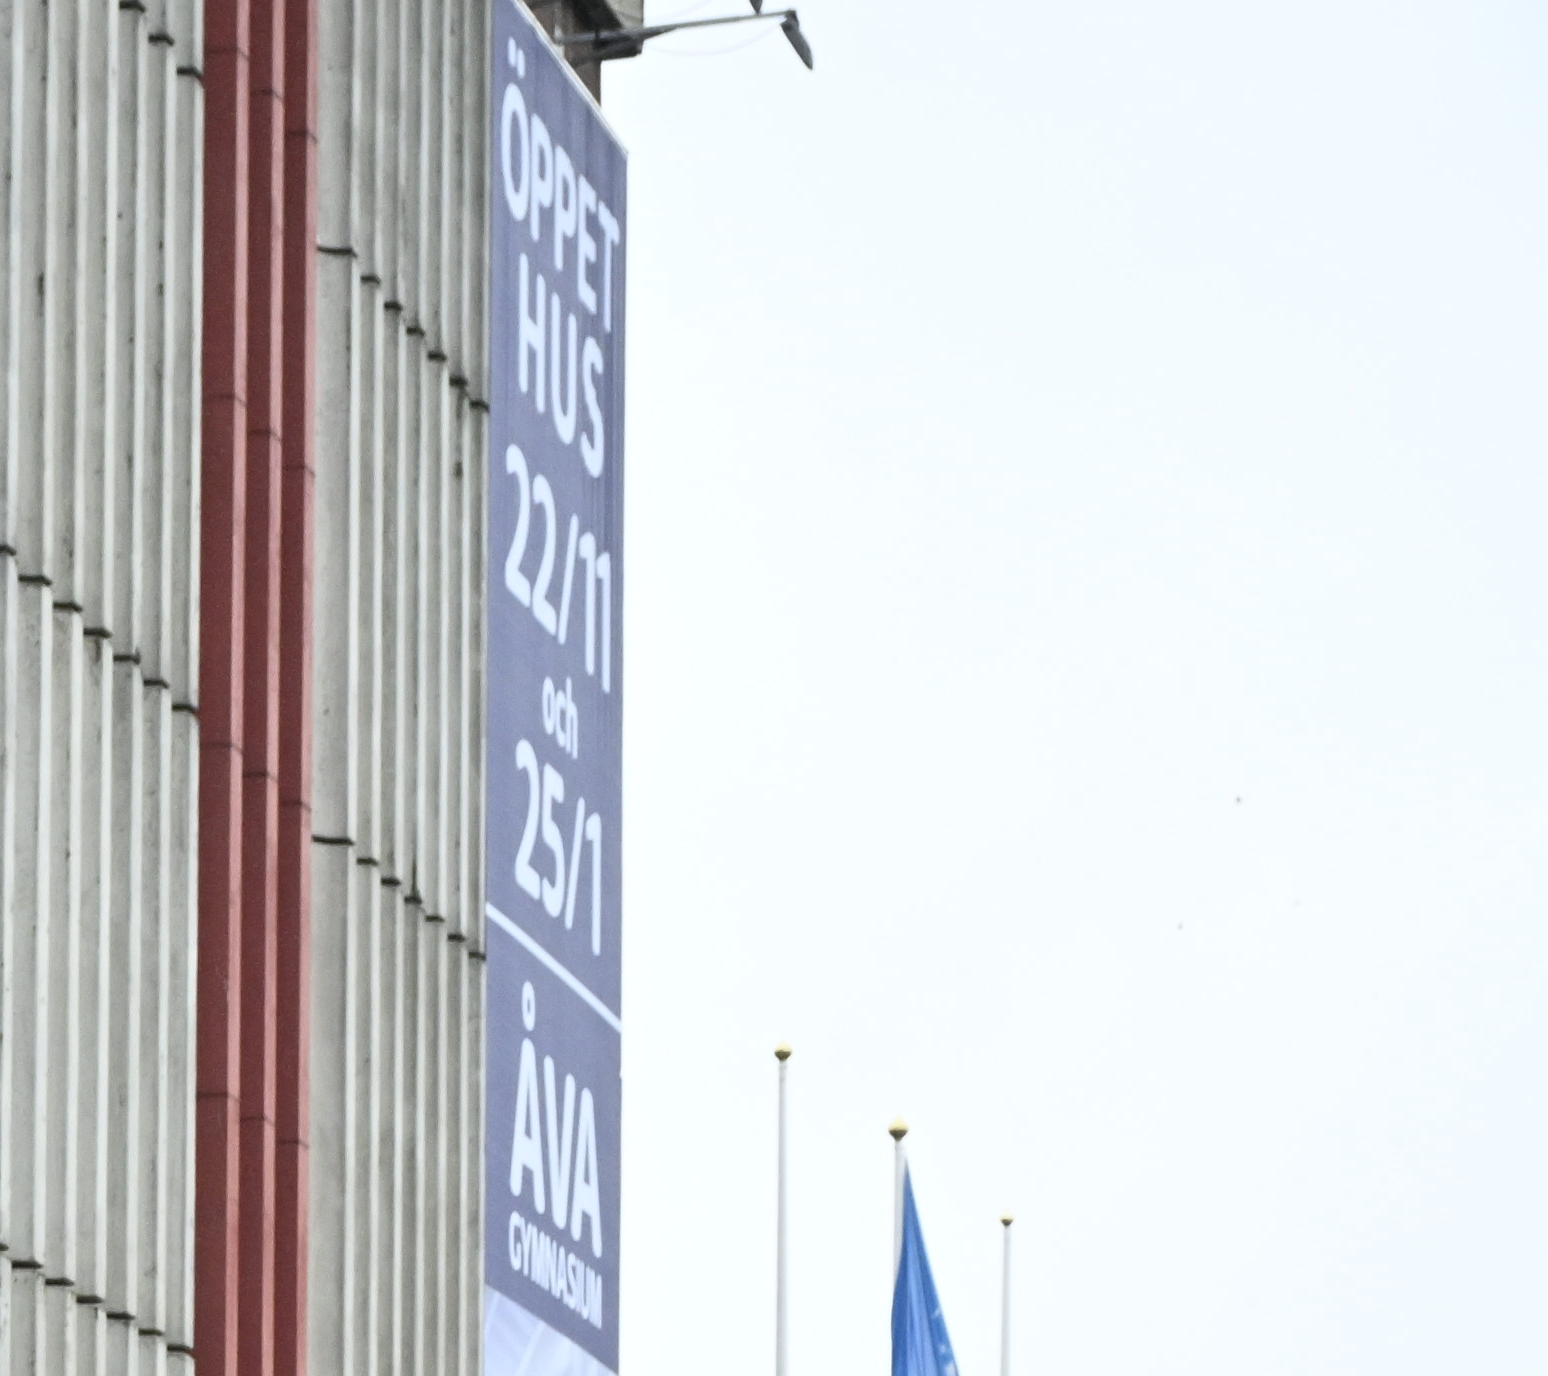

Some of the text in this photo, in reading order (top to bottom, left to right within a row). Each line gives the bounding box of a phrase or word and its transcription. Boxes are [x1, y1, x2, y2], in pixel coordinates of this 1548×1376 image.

[501, 36, 620, 333] ÖPPET
[519, 252, 605, 480] HUS
[505, 443, 611, 694] 22/11
[542, 676, 578, 760] och
[515, 738, 602, 956] 25/1
[509, 980, 603, 1259] ÅVA
[509, 1210, 603, 1330] GYMNASIUM
